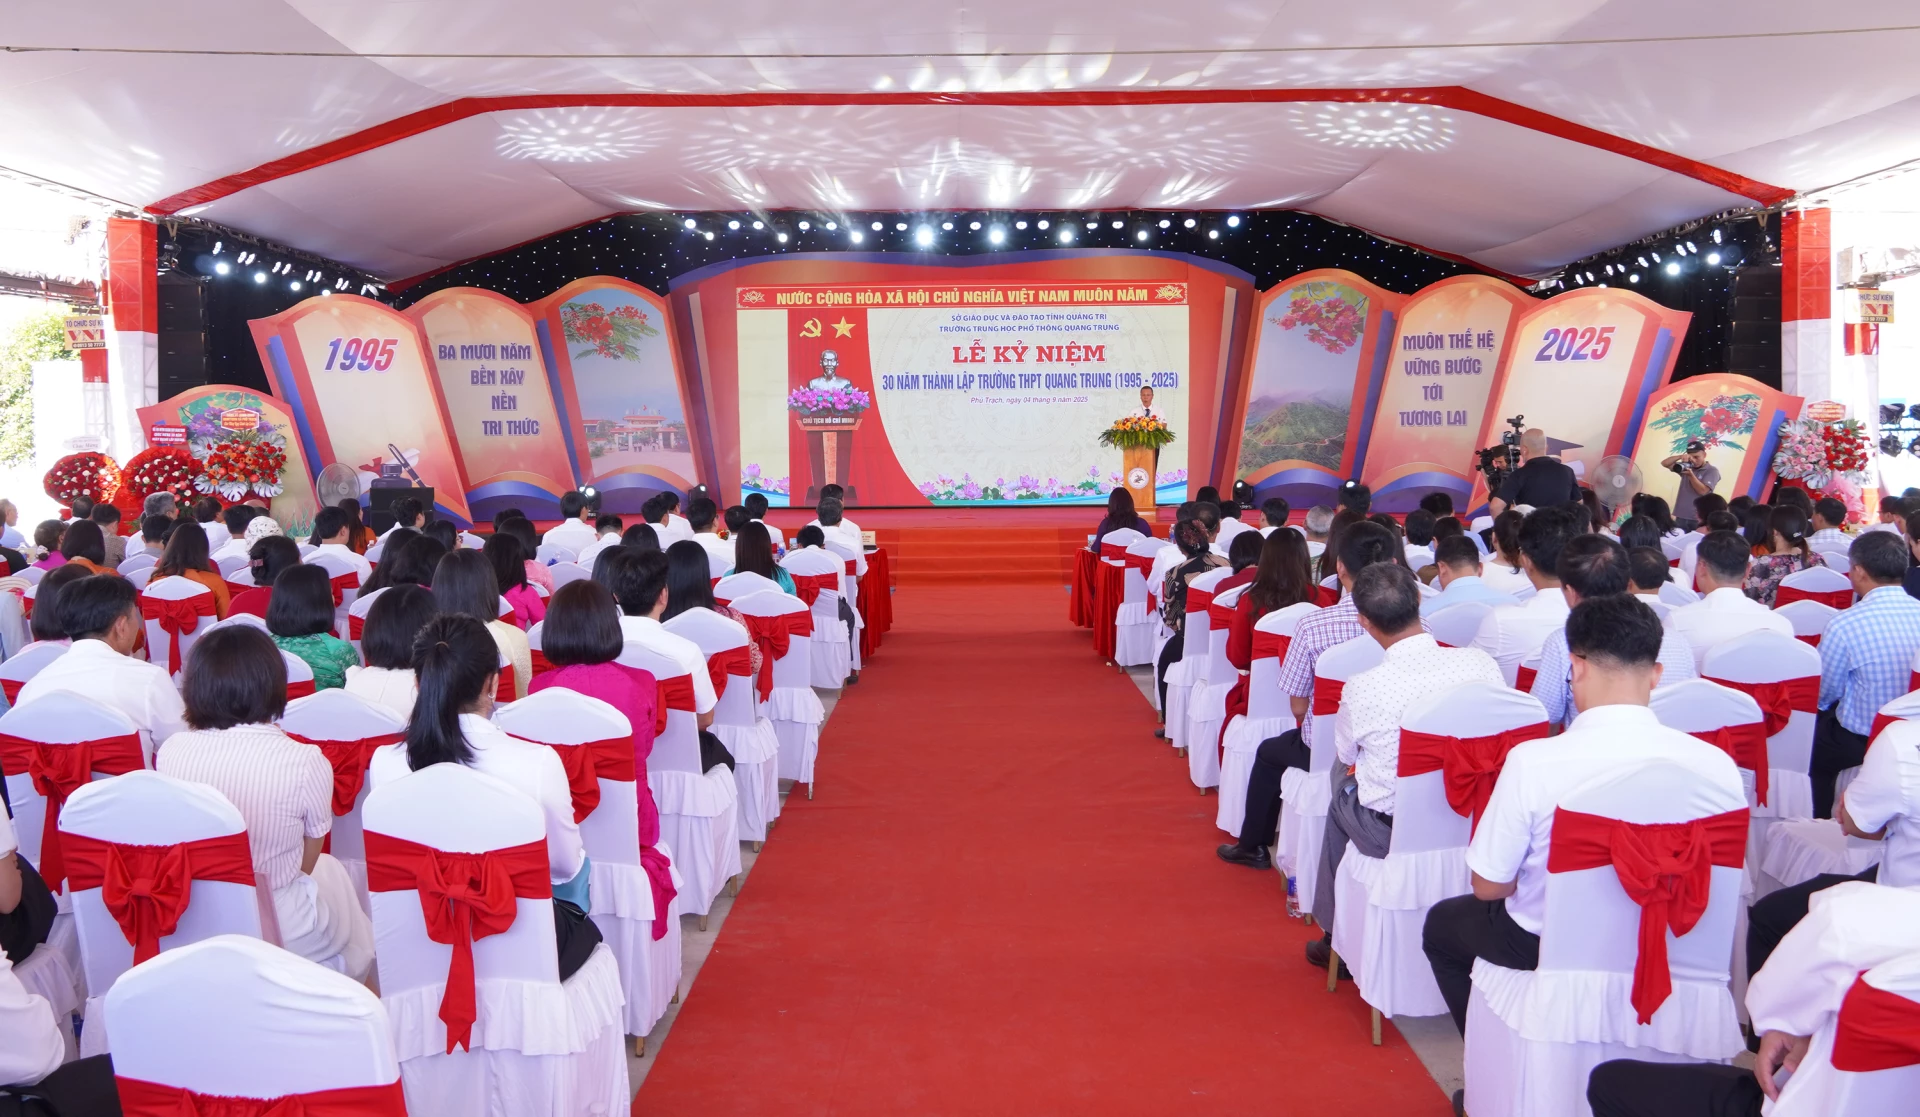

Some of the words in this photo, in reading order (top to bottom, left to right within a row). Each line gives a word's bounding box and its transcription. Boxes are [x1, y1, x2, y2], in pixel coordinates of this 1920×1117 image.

[776, 290, 812, 304] NƯỚC
[816, 290, 852, 307] CỘNG
[856, 289, 882, 304] HÒA
[886, 289, 904, 304] XÃ
[908, 289, 930, 306] HỘI
[934, 288, 960, 304] CHỦ
[964, 288, 1004, 303] NGHĨA
[1008, 288, 1035, 304] VIỆT
[1038, 290, 1070, 302] NAM
[1074, 288, 1112, 302] MUÔN
[1117, 287, 1148, 301] NĂM
[951, 314, 962, 322] SỞ
[963, 313, 982, 322] GIÁO
[983, 314, 999, 322] DỤC
[1000, 326, 1016, 334] HỌC
[1403, 332, 1444, 350] MUÔN
[1448, 328, 1472, 349] THẾ
[1477, 330, 1495, 352] HỆ
[438, 345, 457, 360] BA
[460, 344, 496, 360] MƯƠI
[500, 342, 531, 360] NĂM
[952, 339, 986, 363] LỄ
[993, 340, 1029, 363] KỶ
[1036, 340, 1106, 366] NIỆM
[1534, 326, 1616, 362] 2025
[324, 337, 399, 373] 1995
[471, 365, 496, 385] BỀN
[500, 369, 524, 385] XÂY
[1405, 358, 1440, 376] VỮNG
[1444, 356, 1482, 375] BƯỚC
[882, 374, 894, 390] 30
[897, 372, 919, 390] NĂM
[922, 371, 954, 390] THÀNH
[957, 370, 975, 393] LẬP
[978, 370, 1015, 389] TRƯỜNG
[1018, 373, 1042, 389] THPT
[1045, 373, 1077, 390] QUANG
[1080, 373, 1112, 388] TRUNG
[1116, 372, 1142, 389] (1995
[1151, 372, 1178, 388] 2025)
[492, 390, 517, 410] NỀN
[1422, 383, 1444, 401] TỚI
[482, 420, 503, 436] TRI
[506, 417, 539, 436] THỨC
[1399, 411, 1443, 427] TƯƠNG
[1447, 410, 1467, 426] LAI
